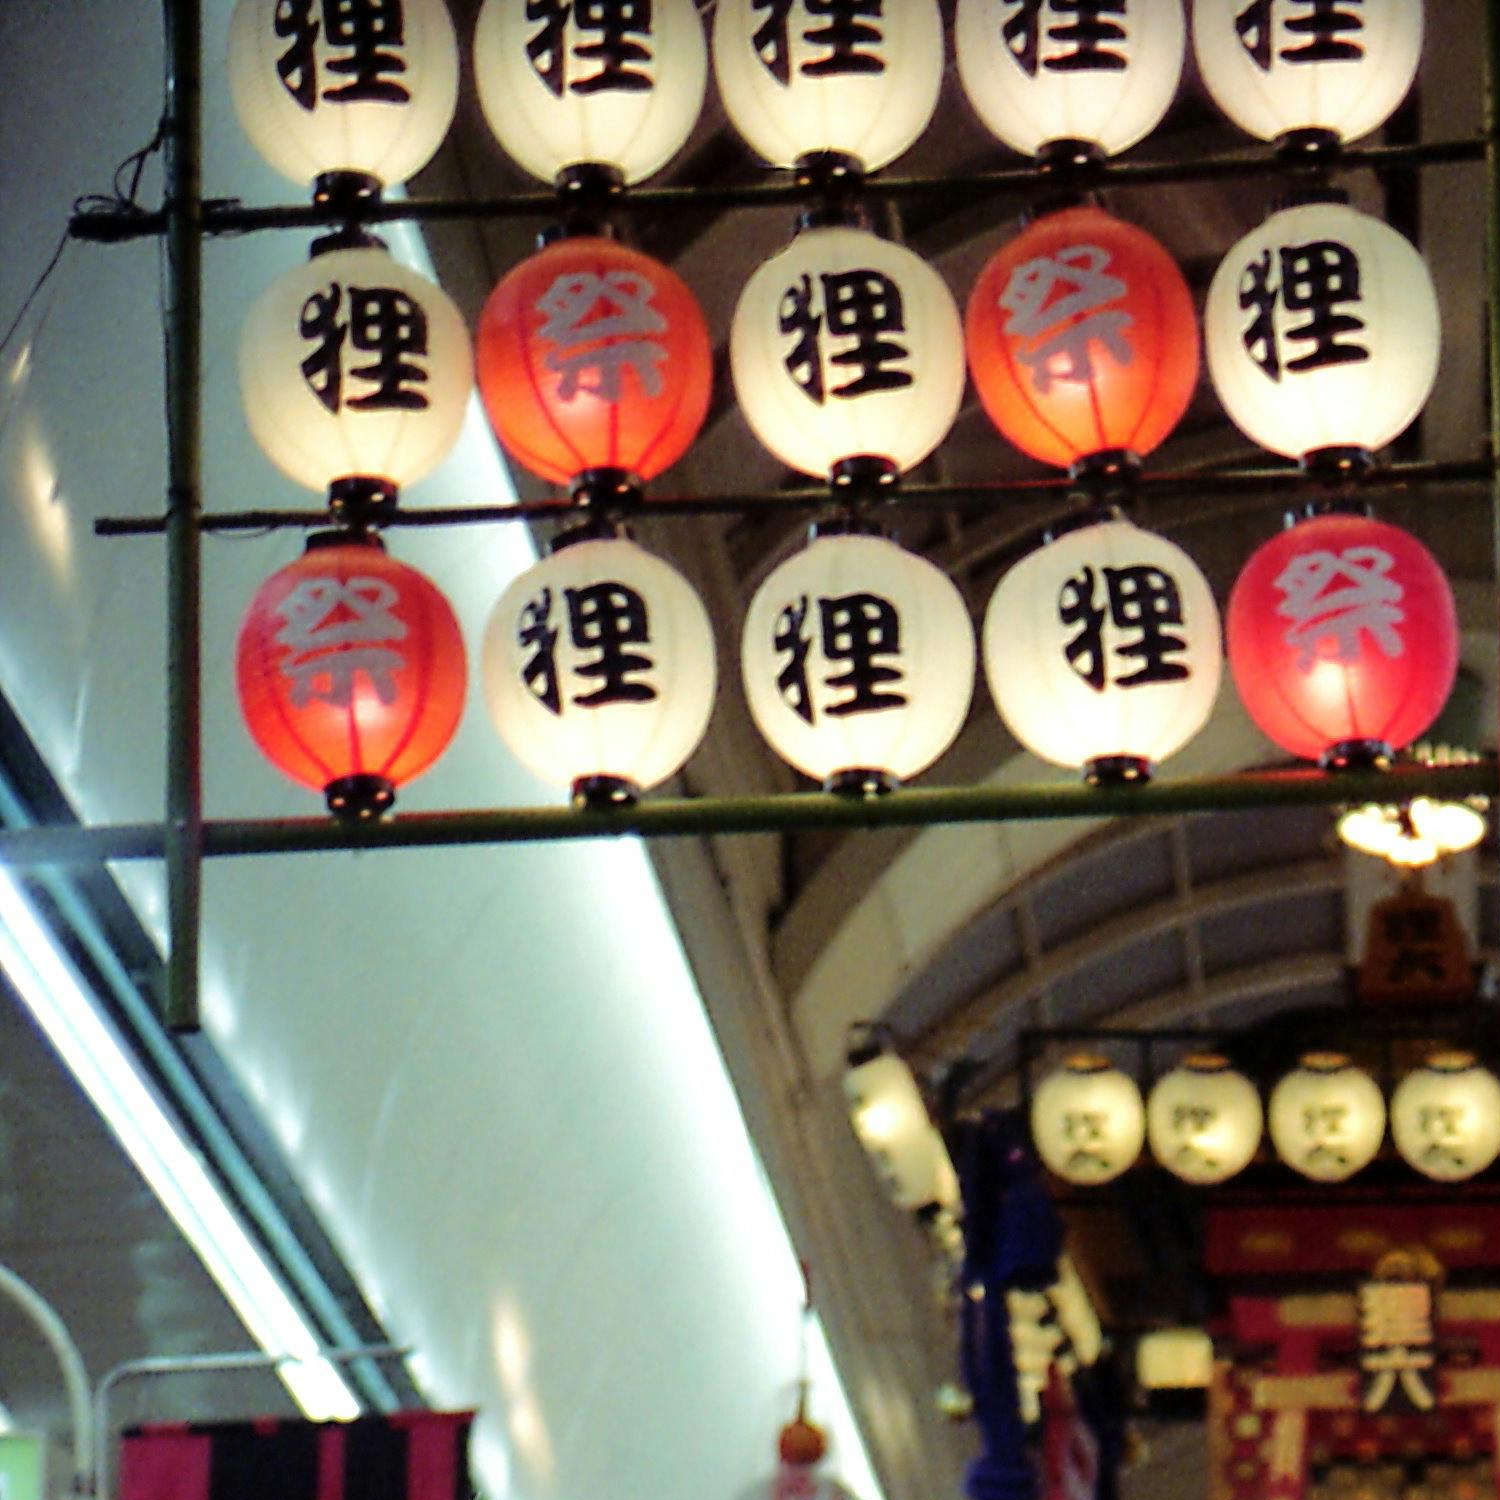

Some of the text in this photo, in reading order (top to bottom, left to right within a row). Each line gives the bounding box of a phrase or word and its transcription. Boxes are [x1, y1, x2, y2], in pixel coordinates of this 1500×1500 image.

[300, 284, 430, 413] 狸
[535, 272, 669, 402] 祭
[777, 268, 914, 406] 狸
[999, 244, 1135, 394] 祭
[1238, 240, 1370, 383] 狸
[273, 577, 408, 709] 祭
[517, 580, 657, 714] 狸
[774, 593, 911, 726] 狸
[1058, 565, 1190, 693] 狸
[1273, 547, 1405, 668] 祭
